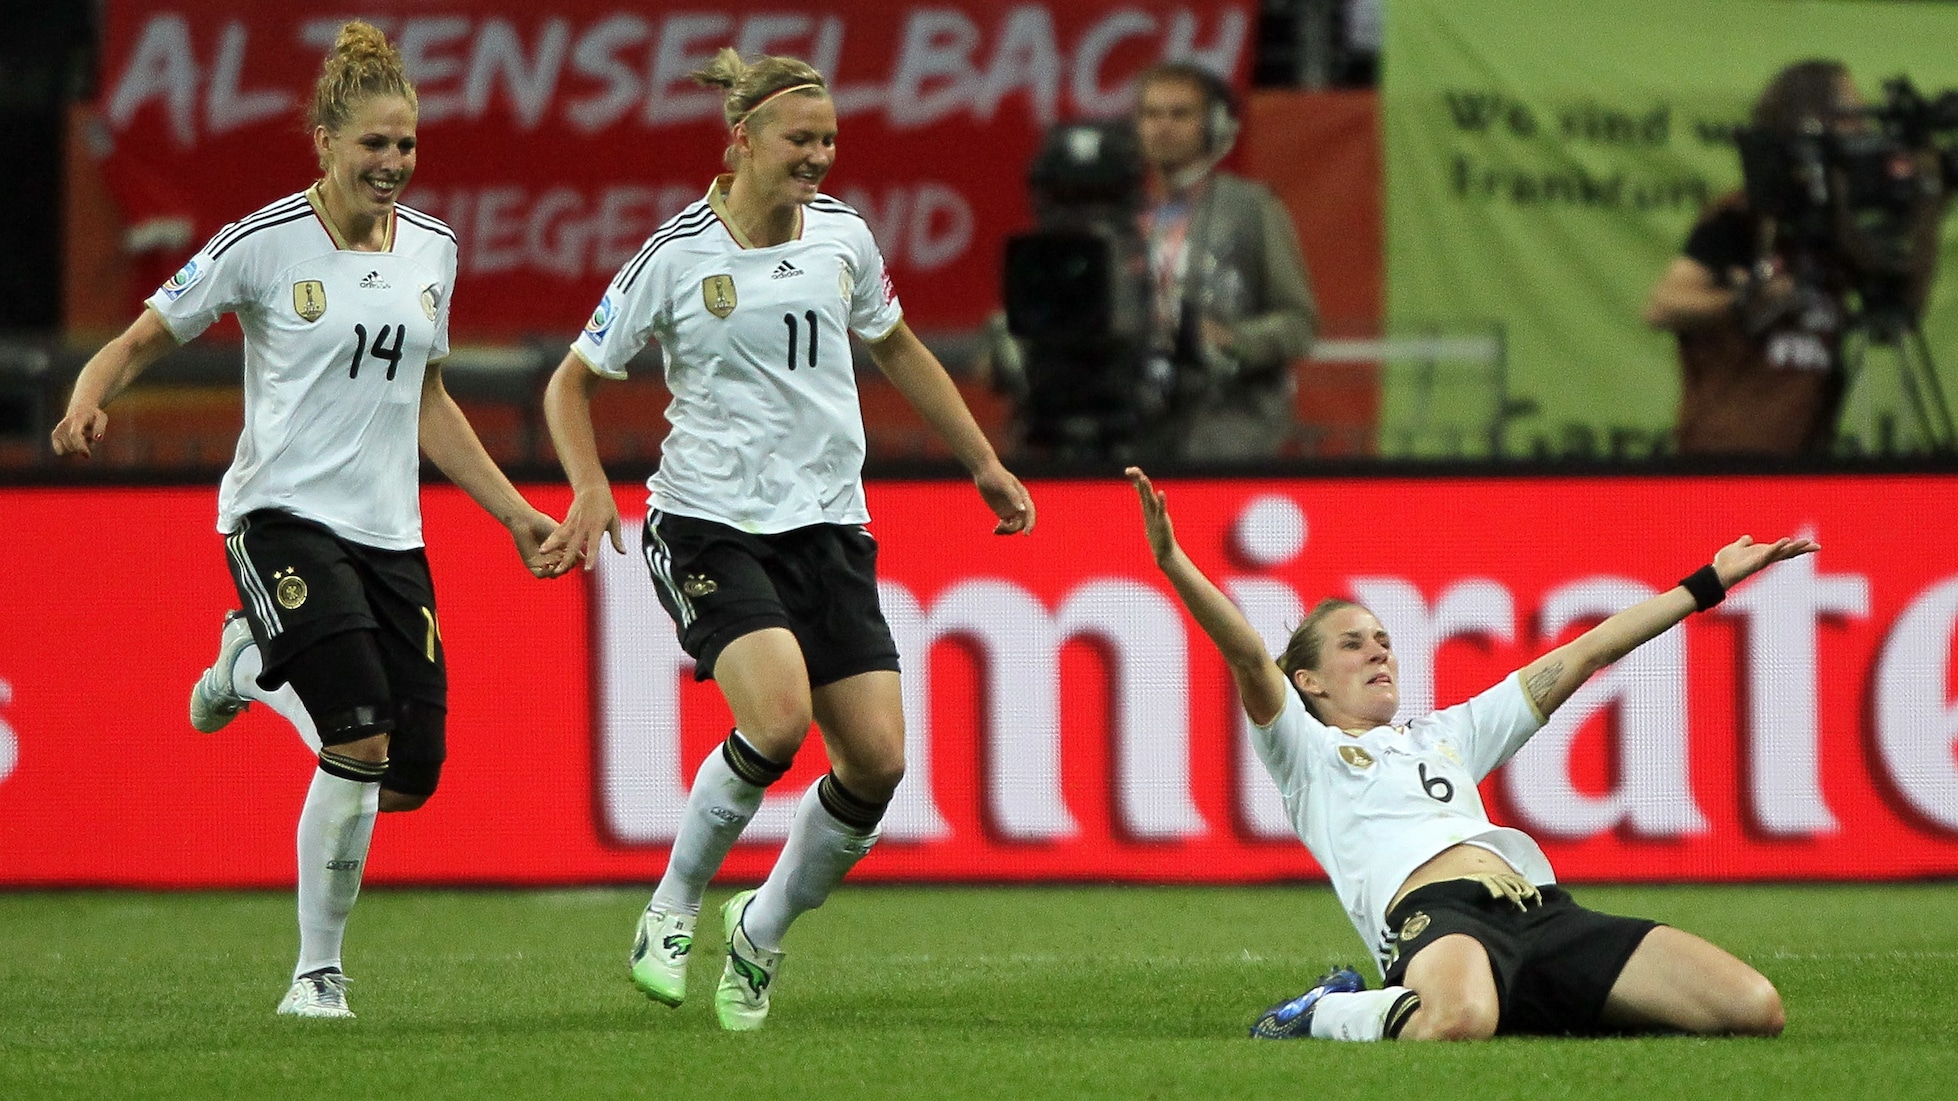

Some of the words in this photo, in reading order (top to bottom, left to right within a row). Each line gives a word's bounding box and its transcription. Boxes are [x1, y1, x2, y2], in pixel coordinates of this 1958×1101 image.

[771, 268, 804, 280] adidas
[349, 323, 406, 381] 14
[784, 310, 818, 371] 11
[421, 606, 442, 663] 1
[1418, 762, 1454, 803] 6
